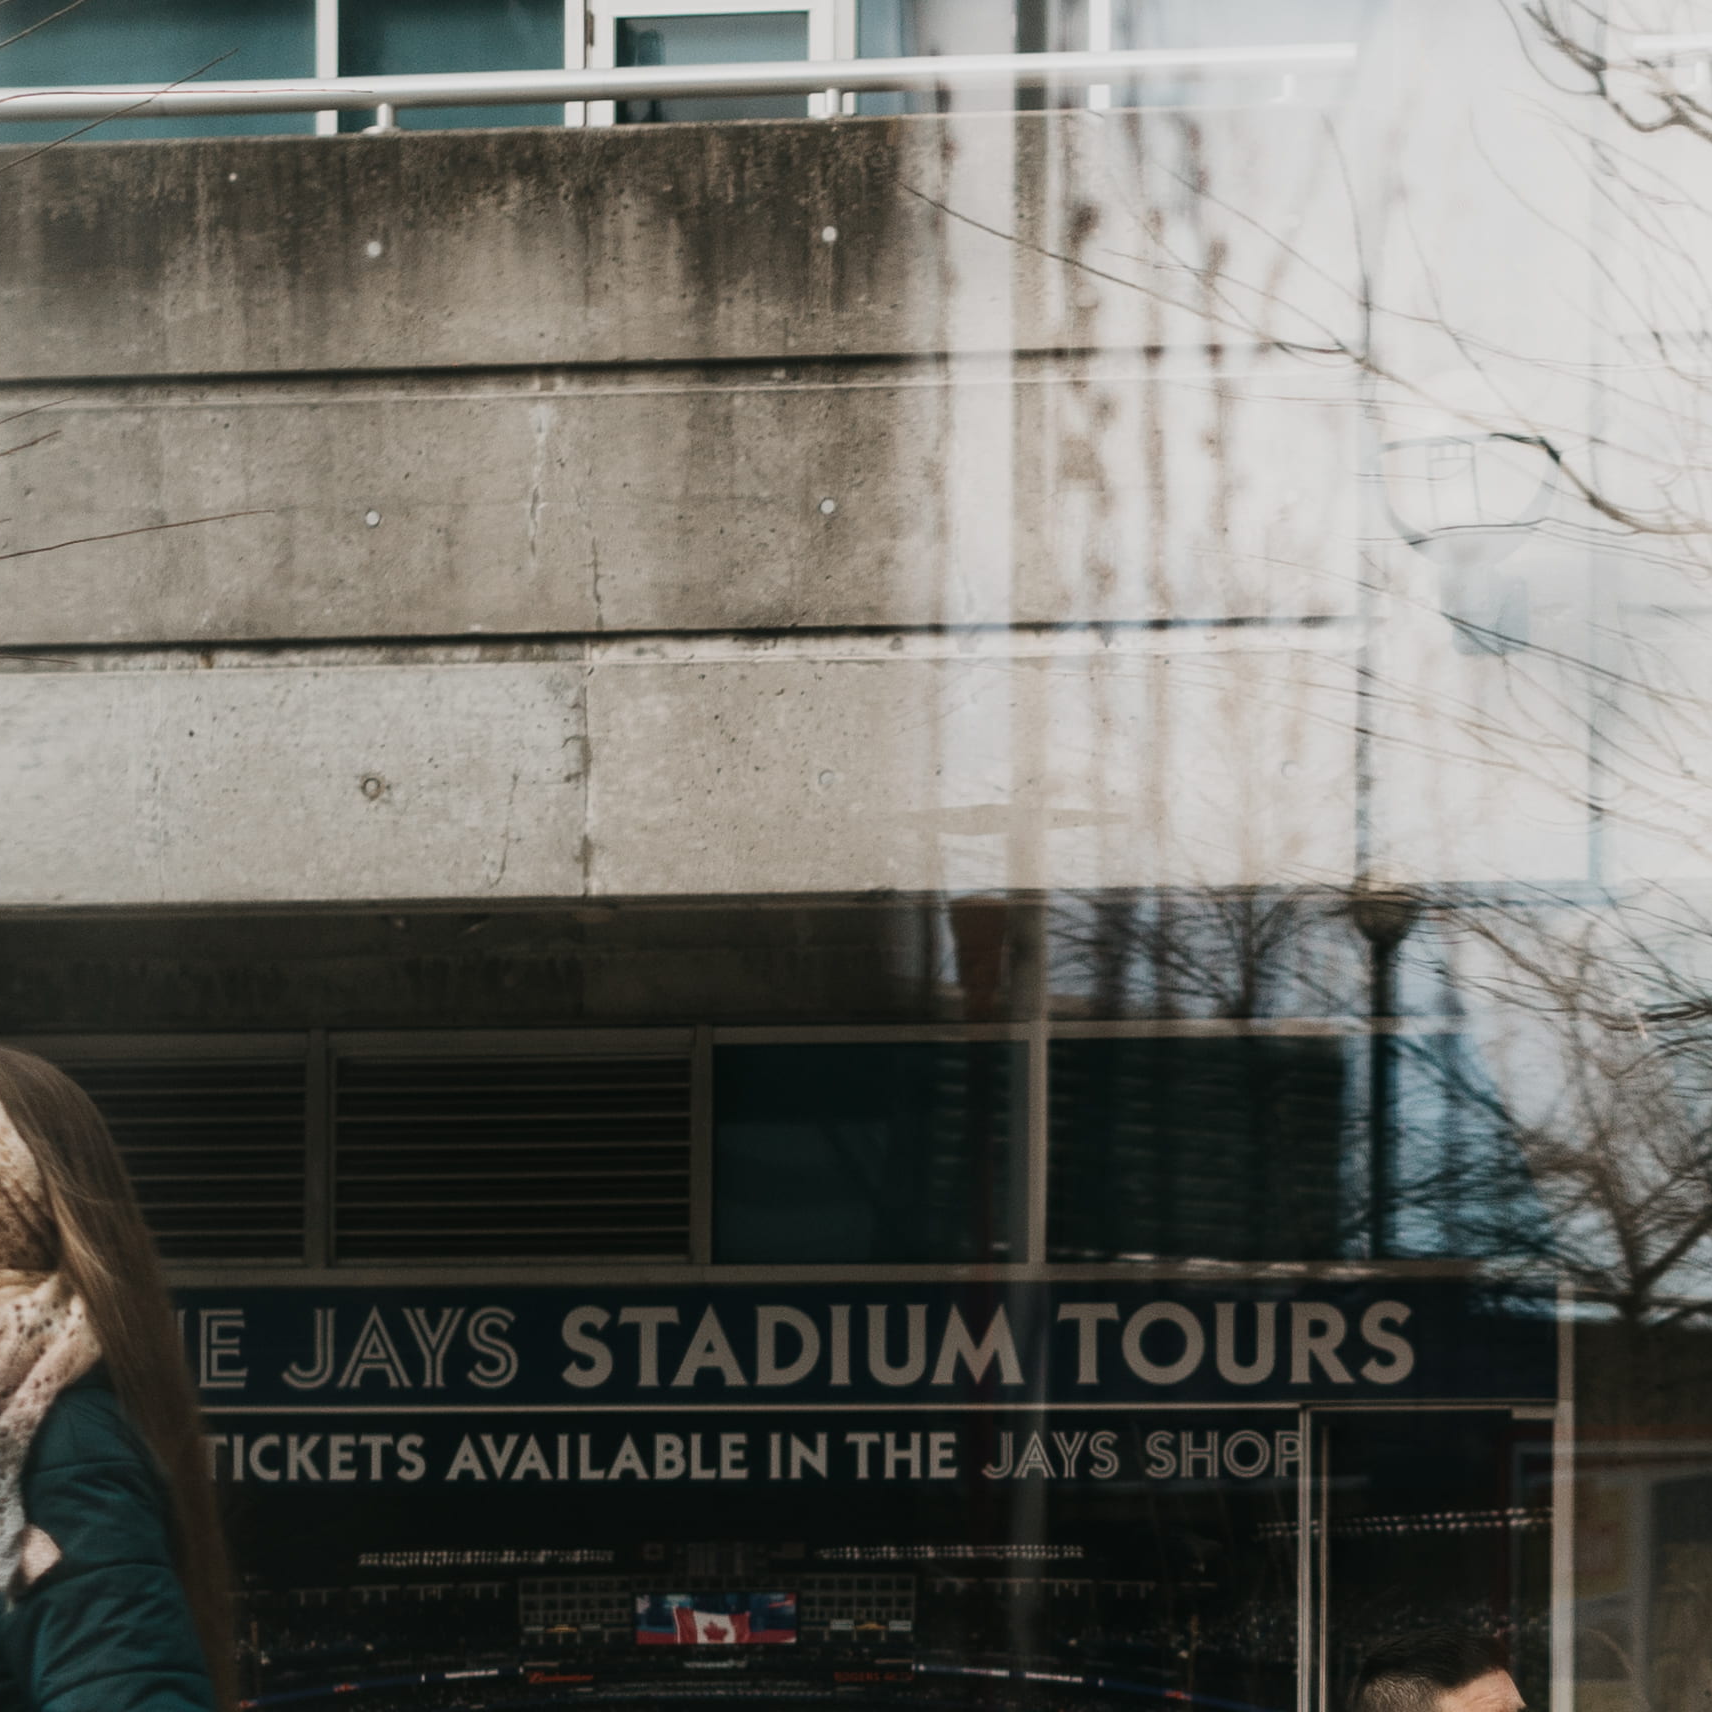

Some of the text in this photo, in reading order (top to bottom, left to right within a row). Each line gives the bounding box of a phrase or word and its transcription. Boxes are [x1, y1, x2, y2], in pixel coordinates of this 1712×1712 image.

[282, 1305, 519, 1389] JAYS
[561, 1303, 1026, 1388] STADIUM
[1057, 1299, 1415, 1386] TOURS
[205, 1429, 1302, 1482] TICKETS AVAILABLE IN THE JAYS SHOP
